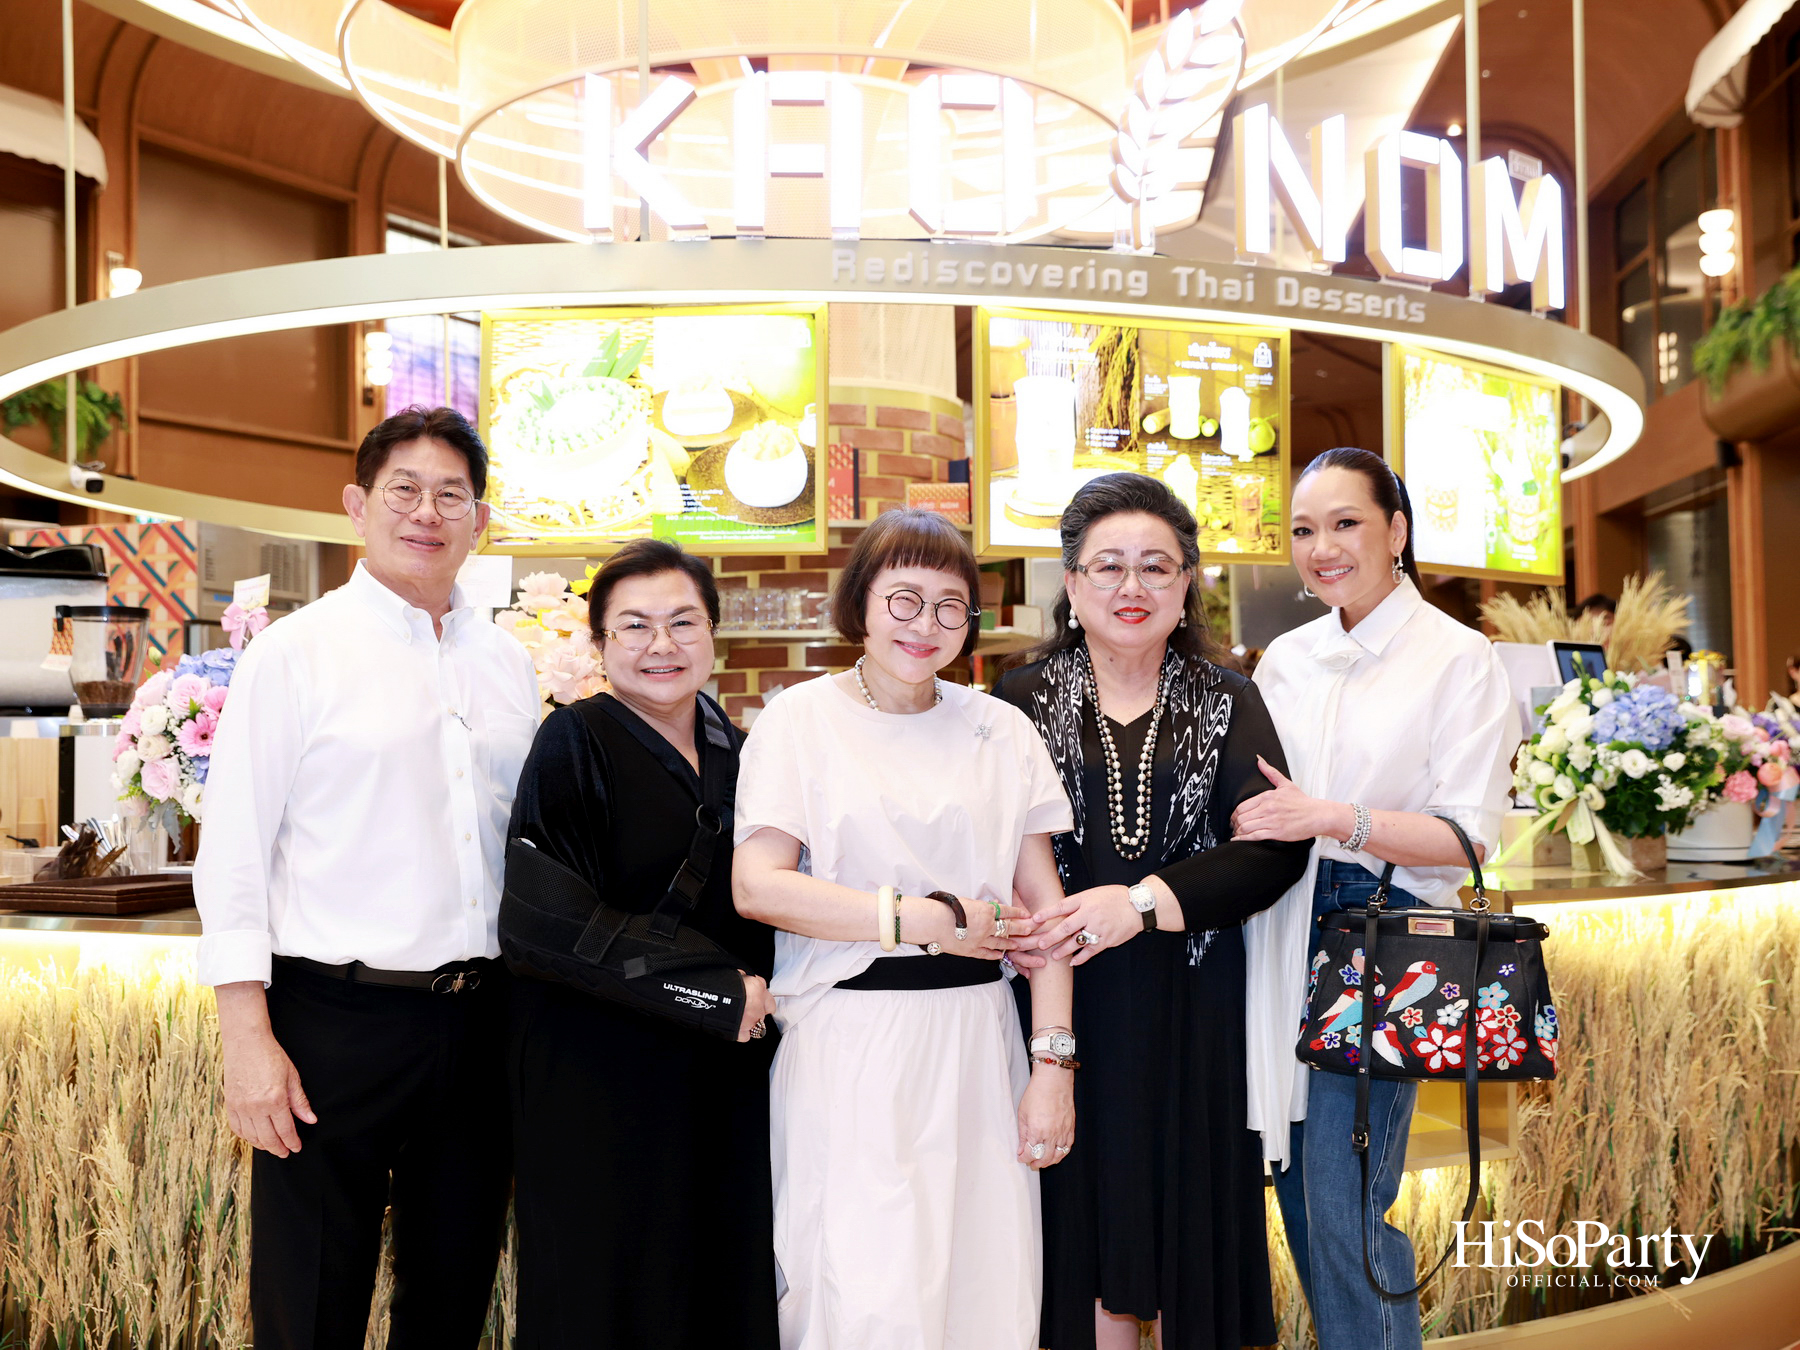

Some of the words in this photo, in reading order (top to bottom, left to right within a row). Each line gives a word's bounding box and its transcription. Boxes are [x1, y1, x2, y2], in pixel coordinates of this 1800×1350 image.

[1234, 103, 1567, 311] NOM
[829, 248, 1149, 298] Rediscovering
[1172, 266, 1255, 305] Thai
[1276, 276, 1428, 325] Desserts
[663, 982, 719, 1001] ULTRASLING
[722, 997, 732, 1005] III
